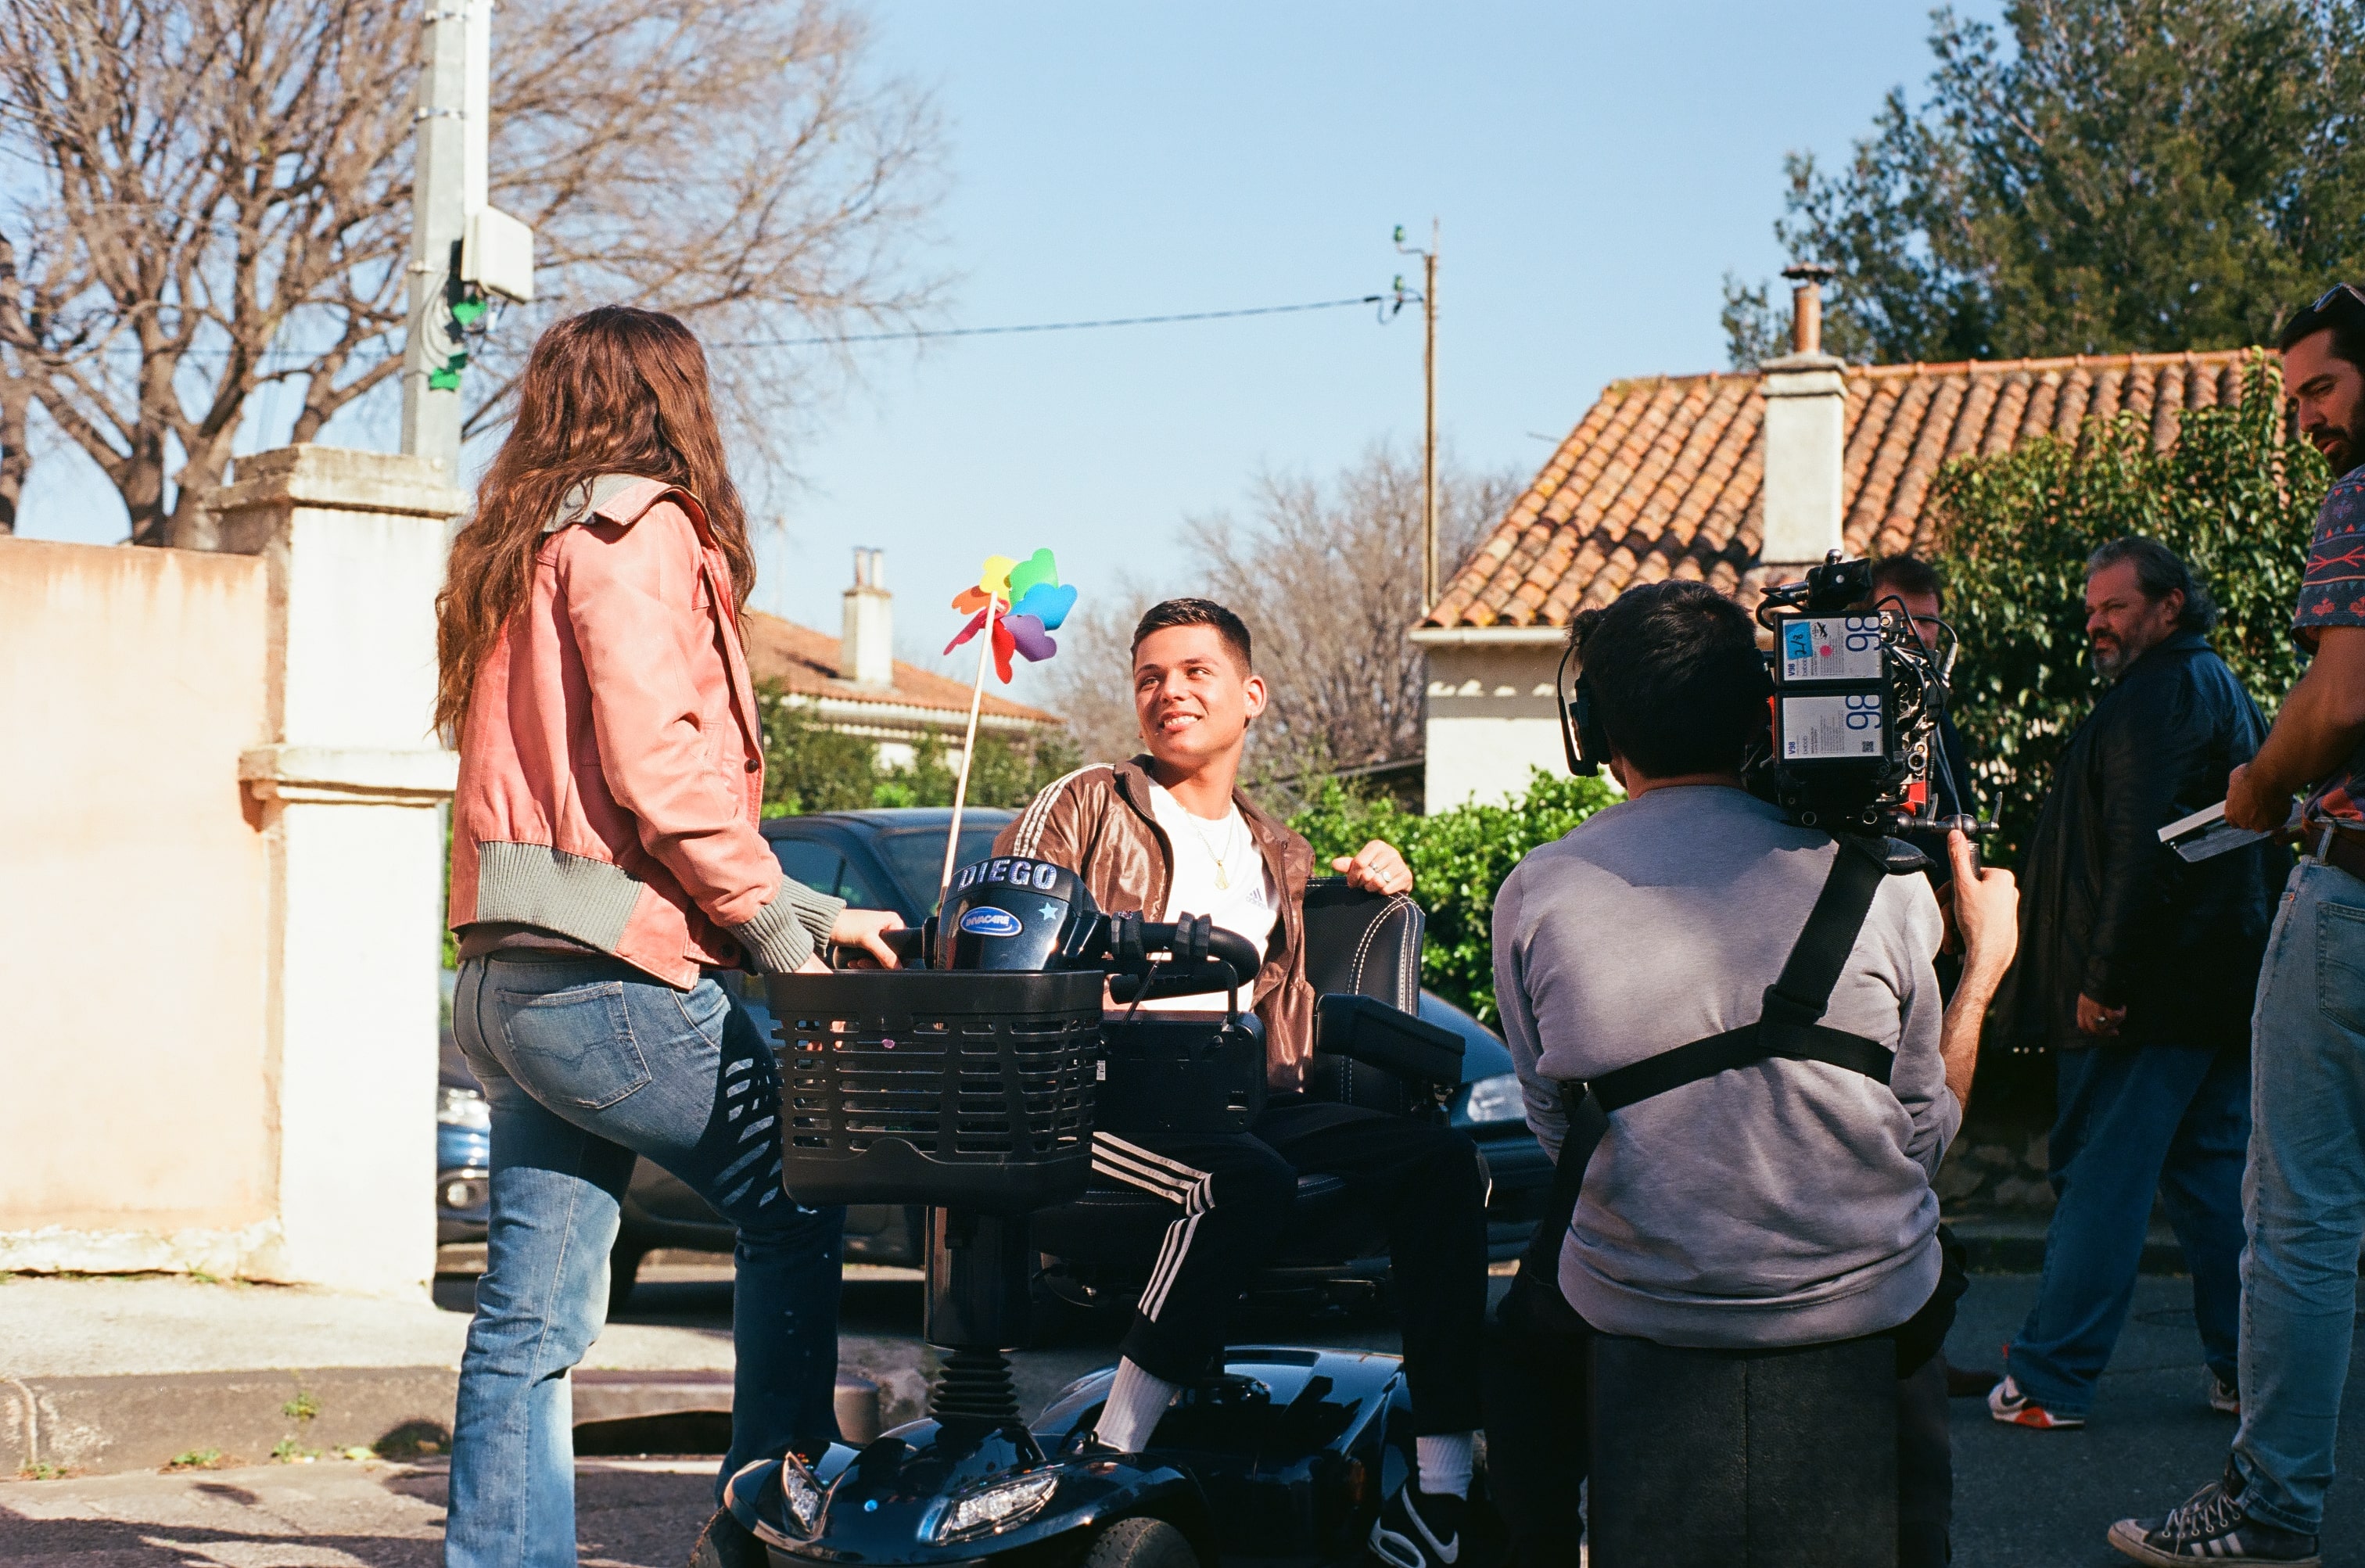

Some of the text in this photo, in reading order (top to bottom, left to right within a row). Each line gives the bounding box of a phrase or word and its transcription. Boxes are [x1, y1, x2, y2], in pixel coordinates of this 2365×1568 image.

[1790, 634, 1807, 655] 2/8
[1846, 616, 1881, 651] 98
[1846, 694, 1882, 730] 98
[957, 859, 1057, 892] DIEGO
[965, 914, 1010, 927] INVACARE
